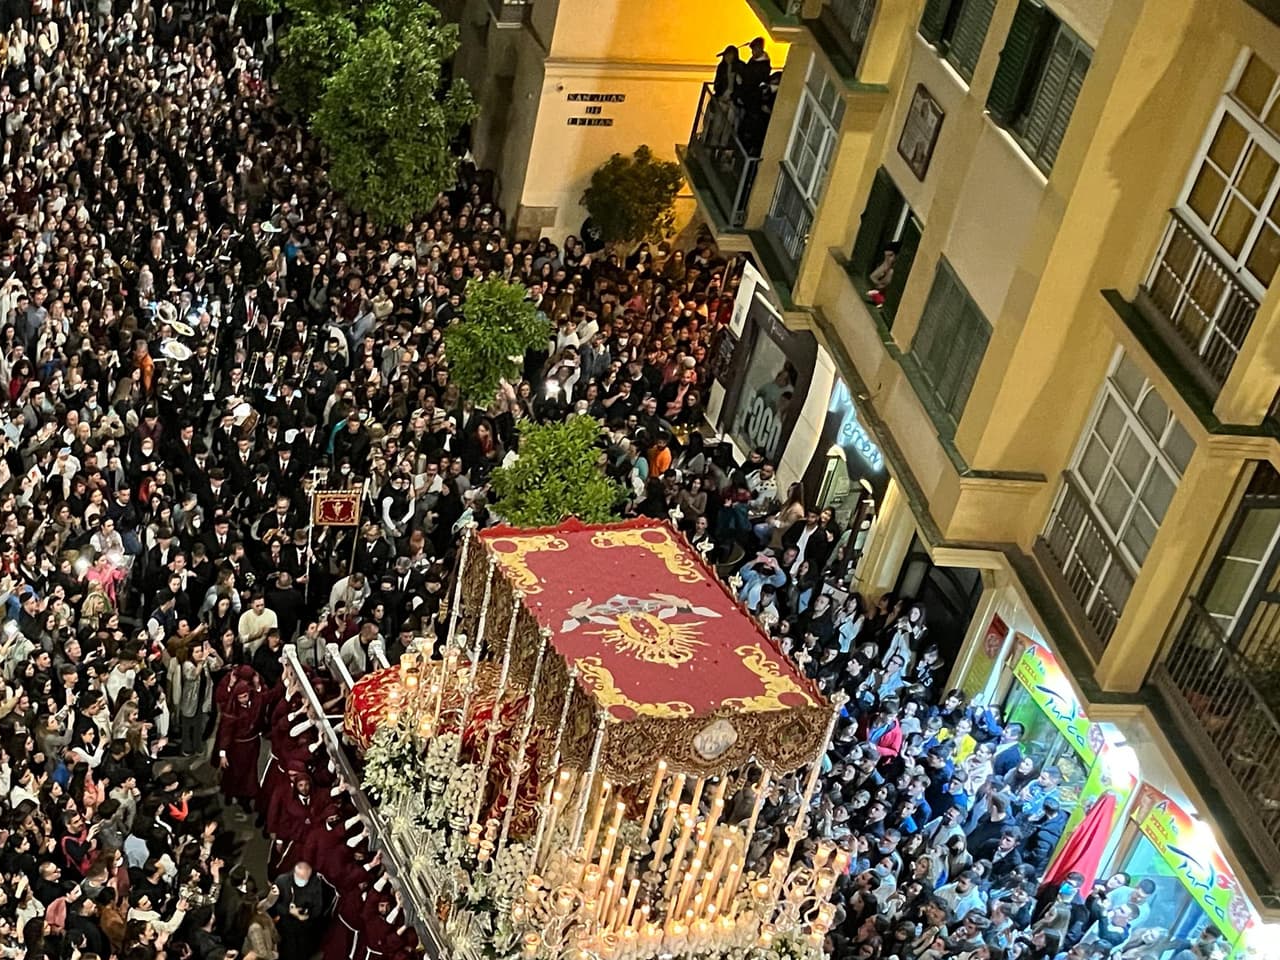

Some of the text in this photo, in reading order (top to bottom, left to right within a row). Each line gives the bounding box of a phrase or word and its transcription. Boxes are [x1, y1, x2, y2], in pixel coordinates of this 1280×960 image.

[567, 93, 625, 103] SAN JUAN
[1166, 843, 1226, 921] Turca
